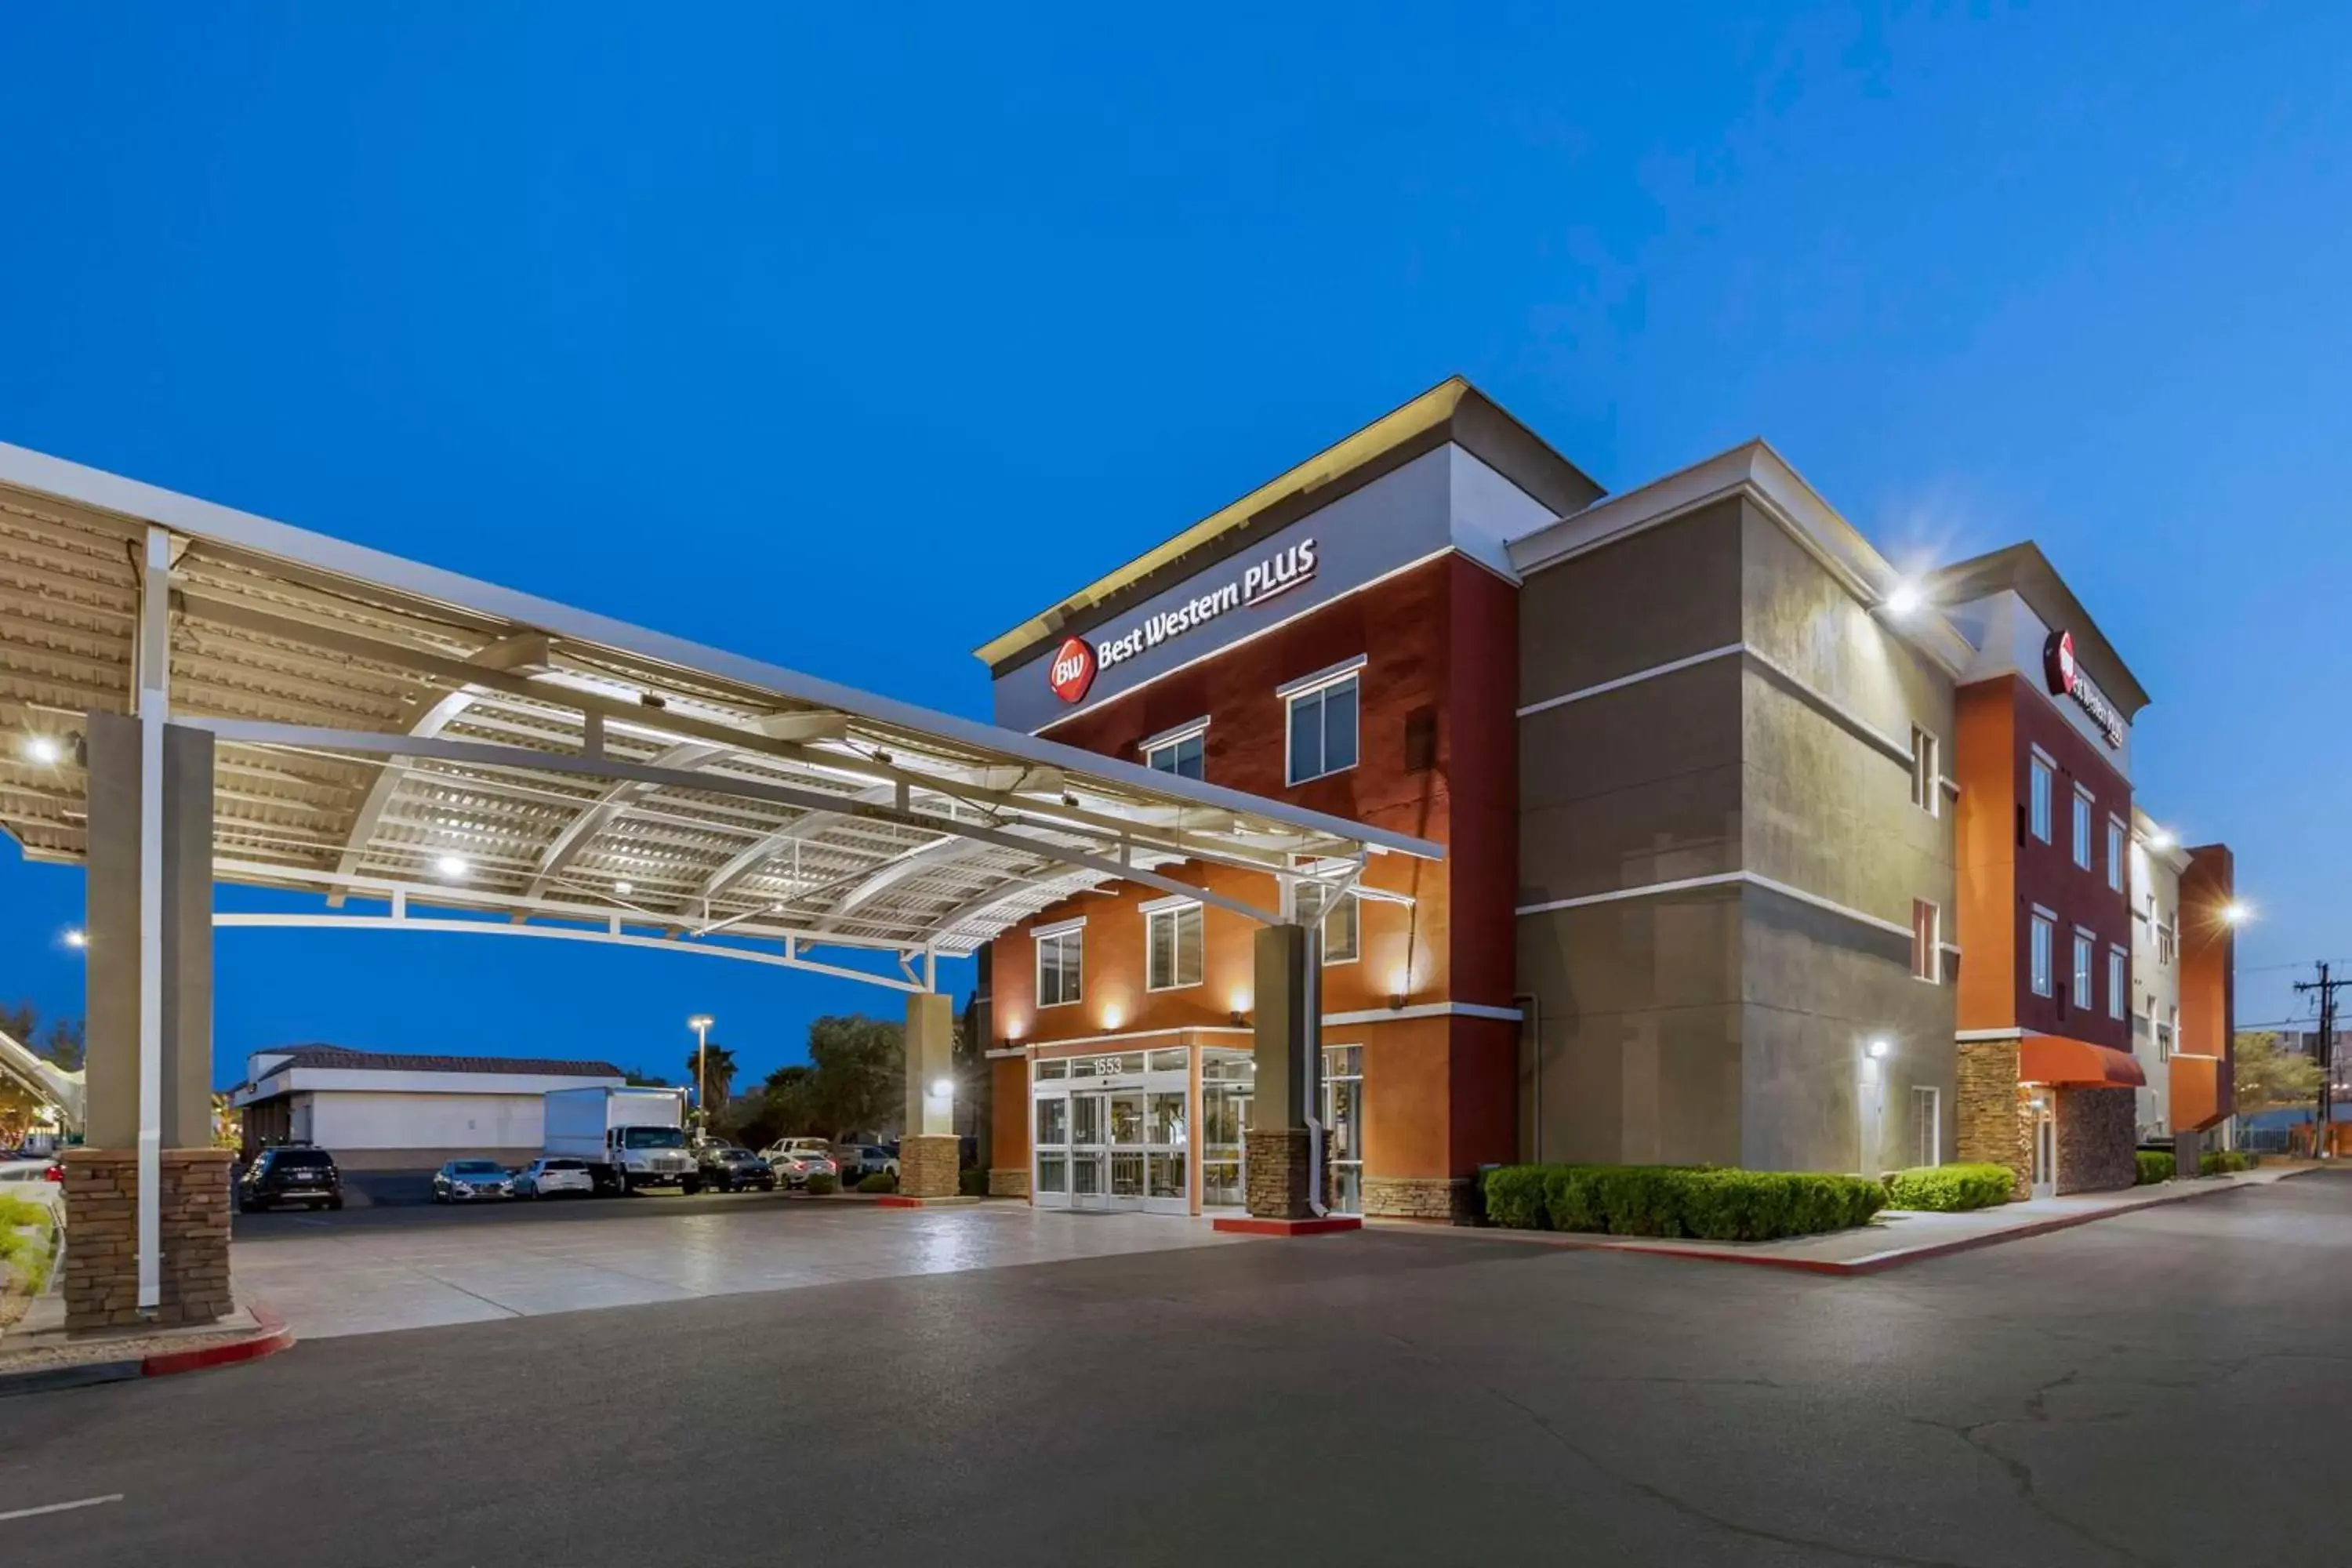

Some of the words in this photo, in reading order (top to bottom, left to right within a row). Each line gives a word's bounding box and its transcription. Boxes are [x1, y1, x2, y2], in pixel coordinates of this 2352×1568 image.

[1098, 628, 1144, 670] Best
[1144, 583, 1239, 646] Western
[1243, 538, 1314, 600] PLUS
[1056, 652, 1085, 688] BW
